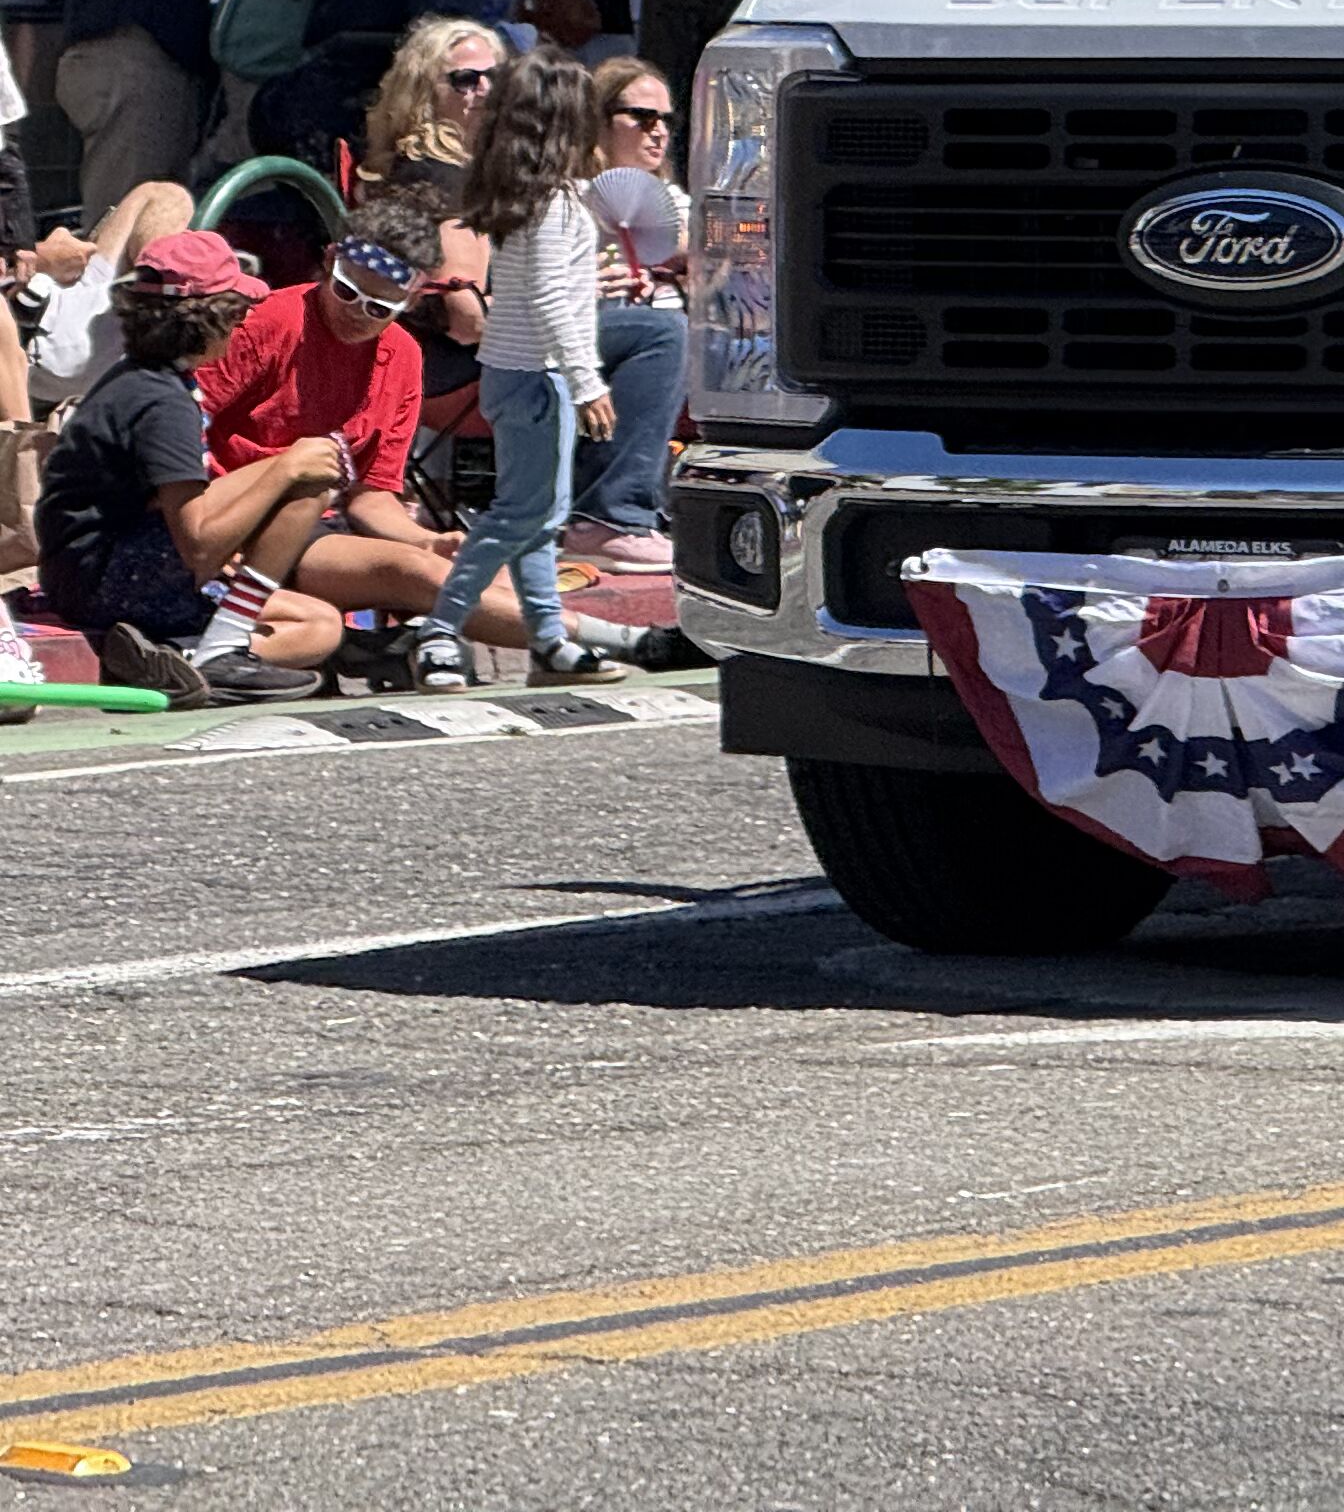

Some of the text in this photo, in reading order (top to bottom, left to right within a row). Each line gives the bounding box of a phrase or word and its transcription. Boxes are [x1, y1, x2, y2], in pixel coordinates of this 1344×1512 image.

[1178, 210, 1298, 266] Ford
[1168, 539, 1292, 555] ALAMEDA ELKS
